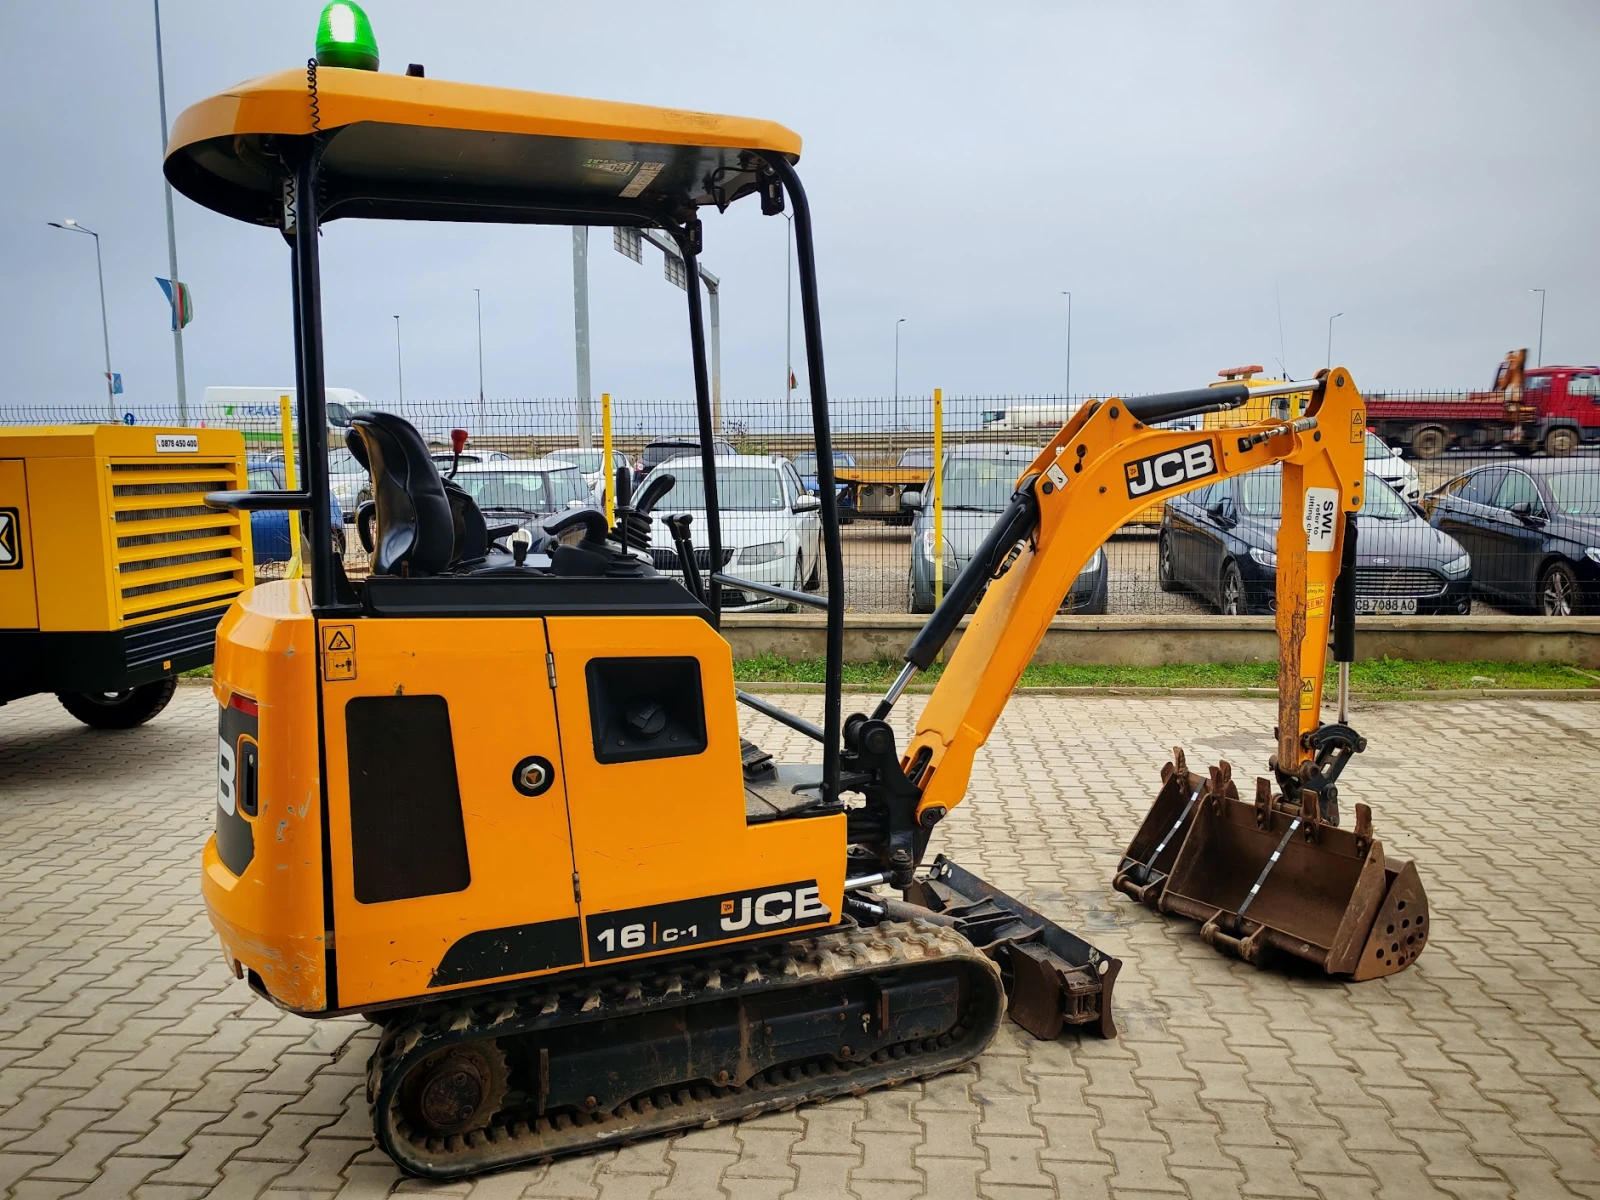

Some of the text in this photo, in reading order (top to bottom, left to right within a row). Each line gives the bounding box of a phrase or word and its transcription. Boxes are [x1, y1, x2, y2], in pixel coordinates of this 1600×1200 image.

[161, 439, 198, 448] 0878 450 400
[1129, 444, 1214, 495] JCB
[1306, 495, 1315, 520] lifting
[1321, 500, 1333, 540] SWL
[1313, 526, 1320, 535] to
[1355, 599, 1369, 611] CB
[1372, 599, 1398, 611] 7088
[720, 886, 831, 932] JCB
[597, 923, 697, 952] 16 C-1
